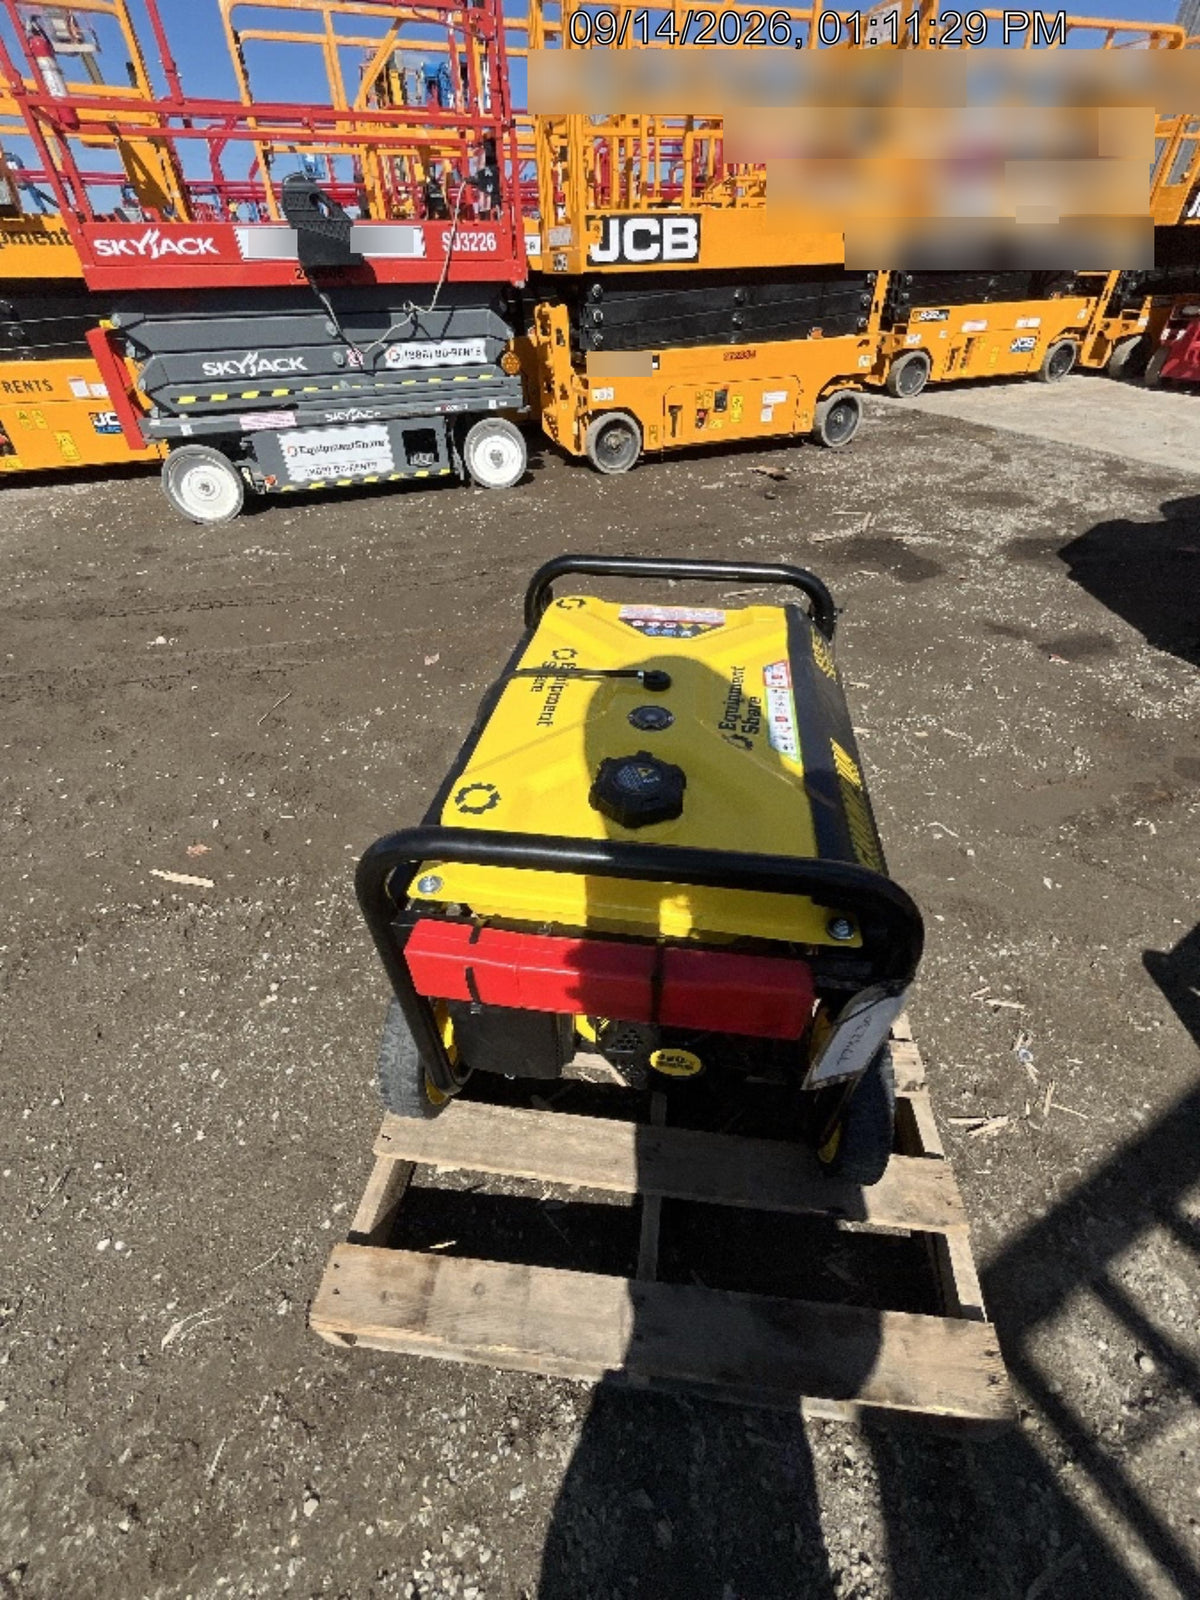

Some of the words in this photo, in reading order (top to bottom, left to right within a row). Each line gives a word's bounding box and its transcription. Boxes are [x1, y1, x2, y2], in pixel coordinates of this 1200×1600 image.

[93, 228, 219, 260] SKYJACK
[441, 231, 497, 252] SJ3226
[589, 217, 698, 262] JCB
[202, 351, 308, 377] SKYJACK
[1, 379, 54, 394] RENTS
[531, 660, 557, 692] Sare
[536, 662, 576, 727] Euipment
[718, 666, 746, 731] Equipment
[741, 696, 762, 735] Share
